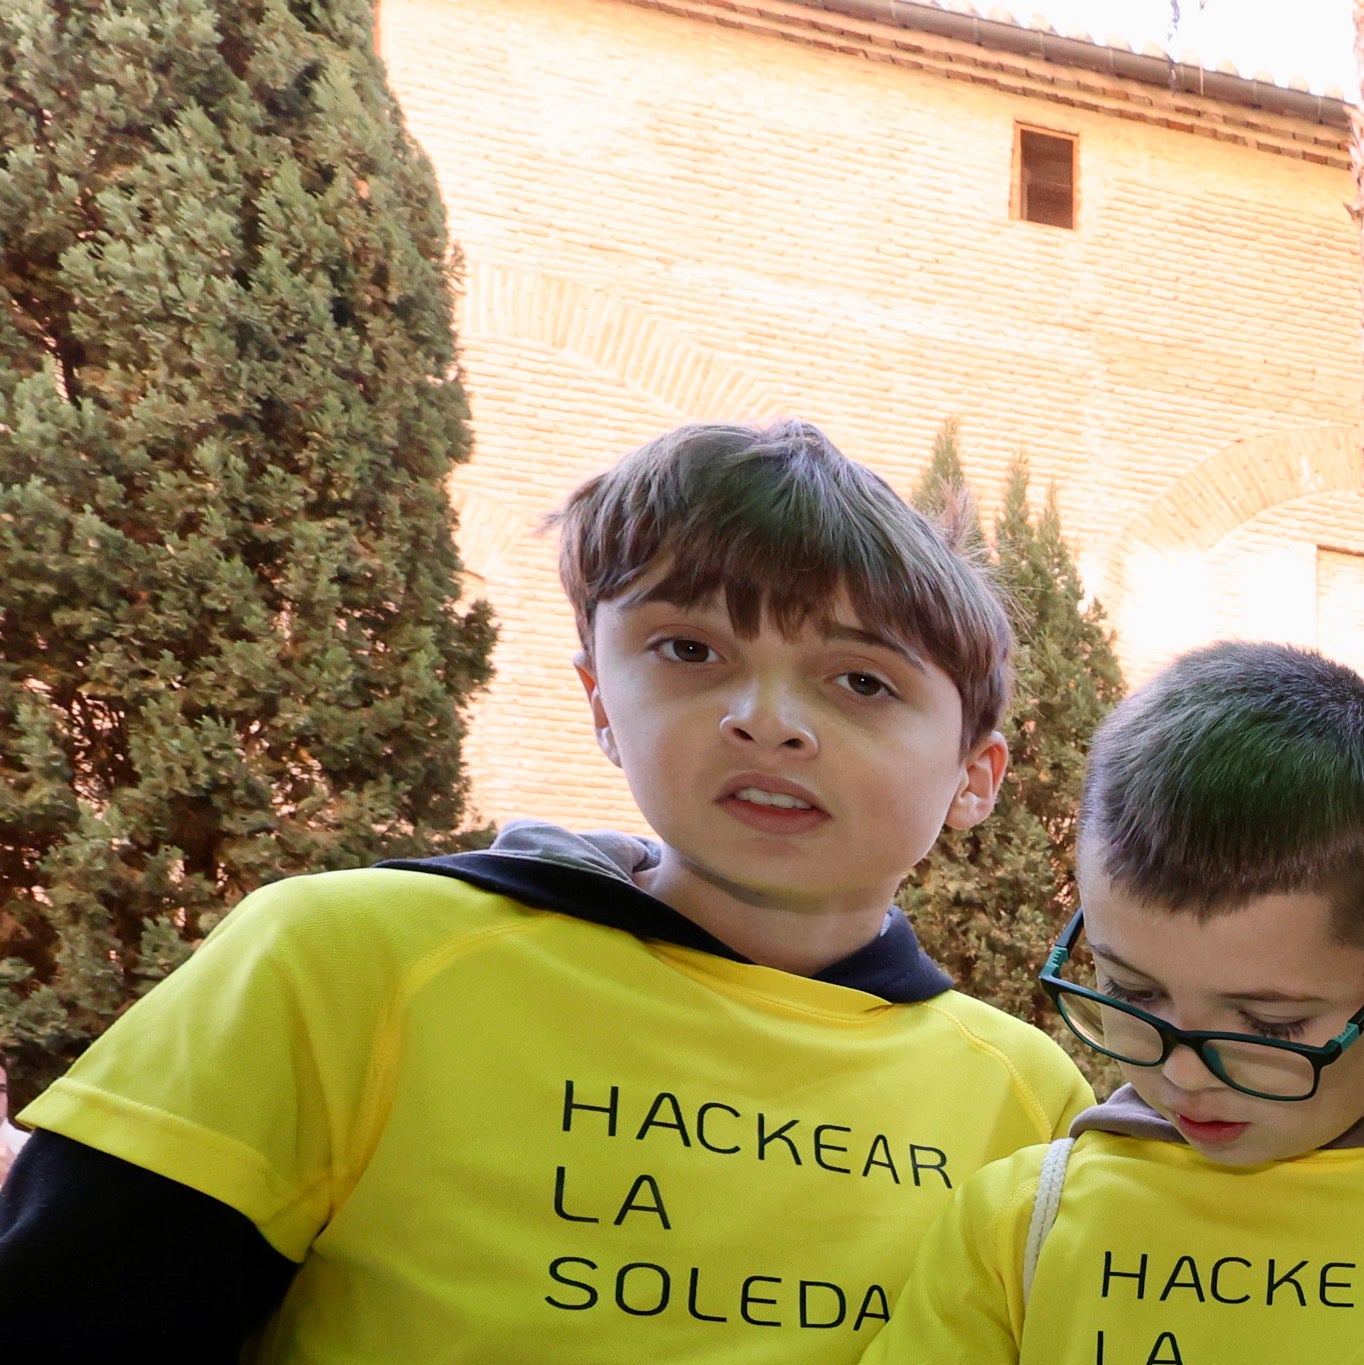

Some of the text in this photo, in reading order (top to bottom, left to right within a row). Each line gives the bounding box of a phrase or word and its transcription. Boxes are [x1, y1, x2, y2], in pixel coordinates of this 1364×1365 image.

[562, 1080, 953, 1189] HACKEAR
[553, 1166, 672, 1229] LA
[544, 1257, 891, 1331] SOLEDA
